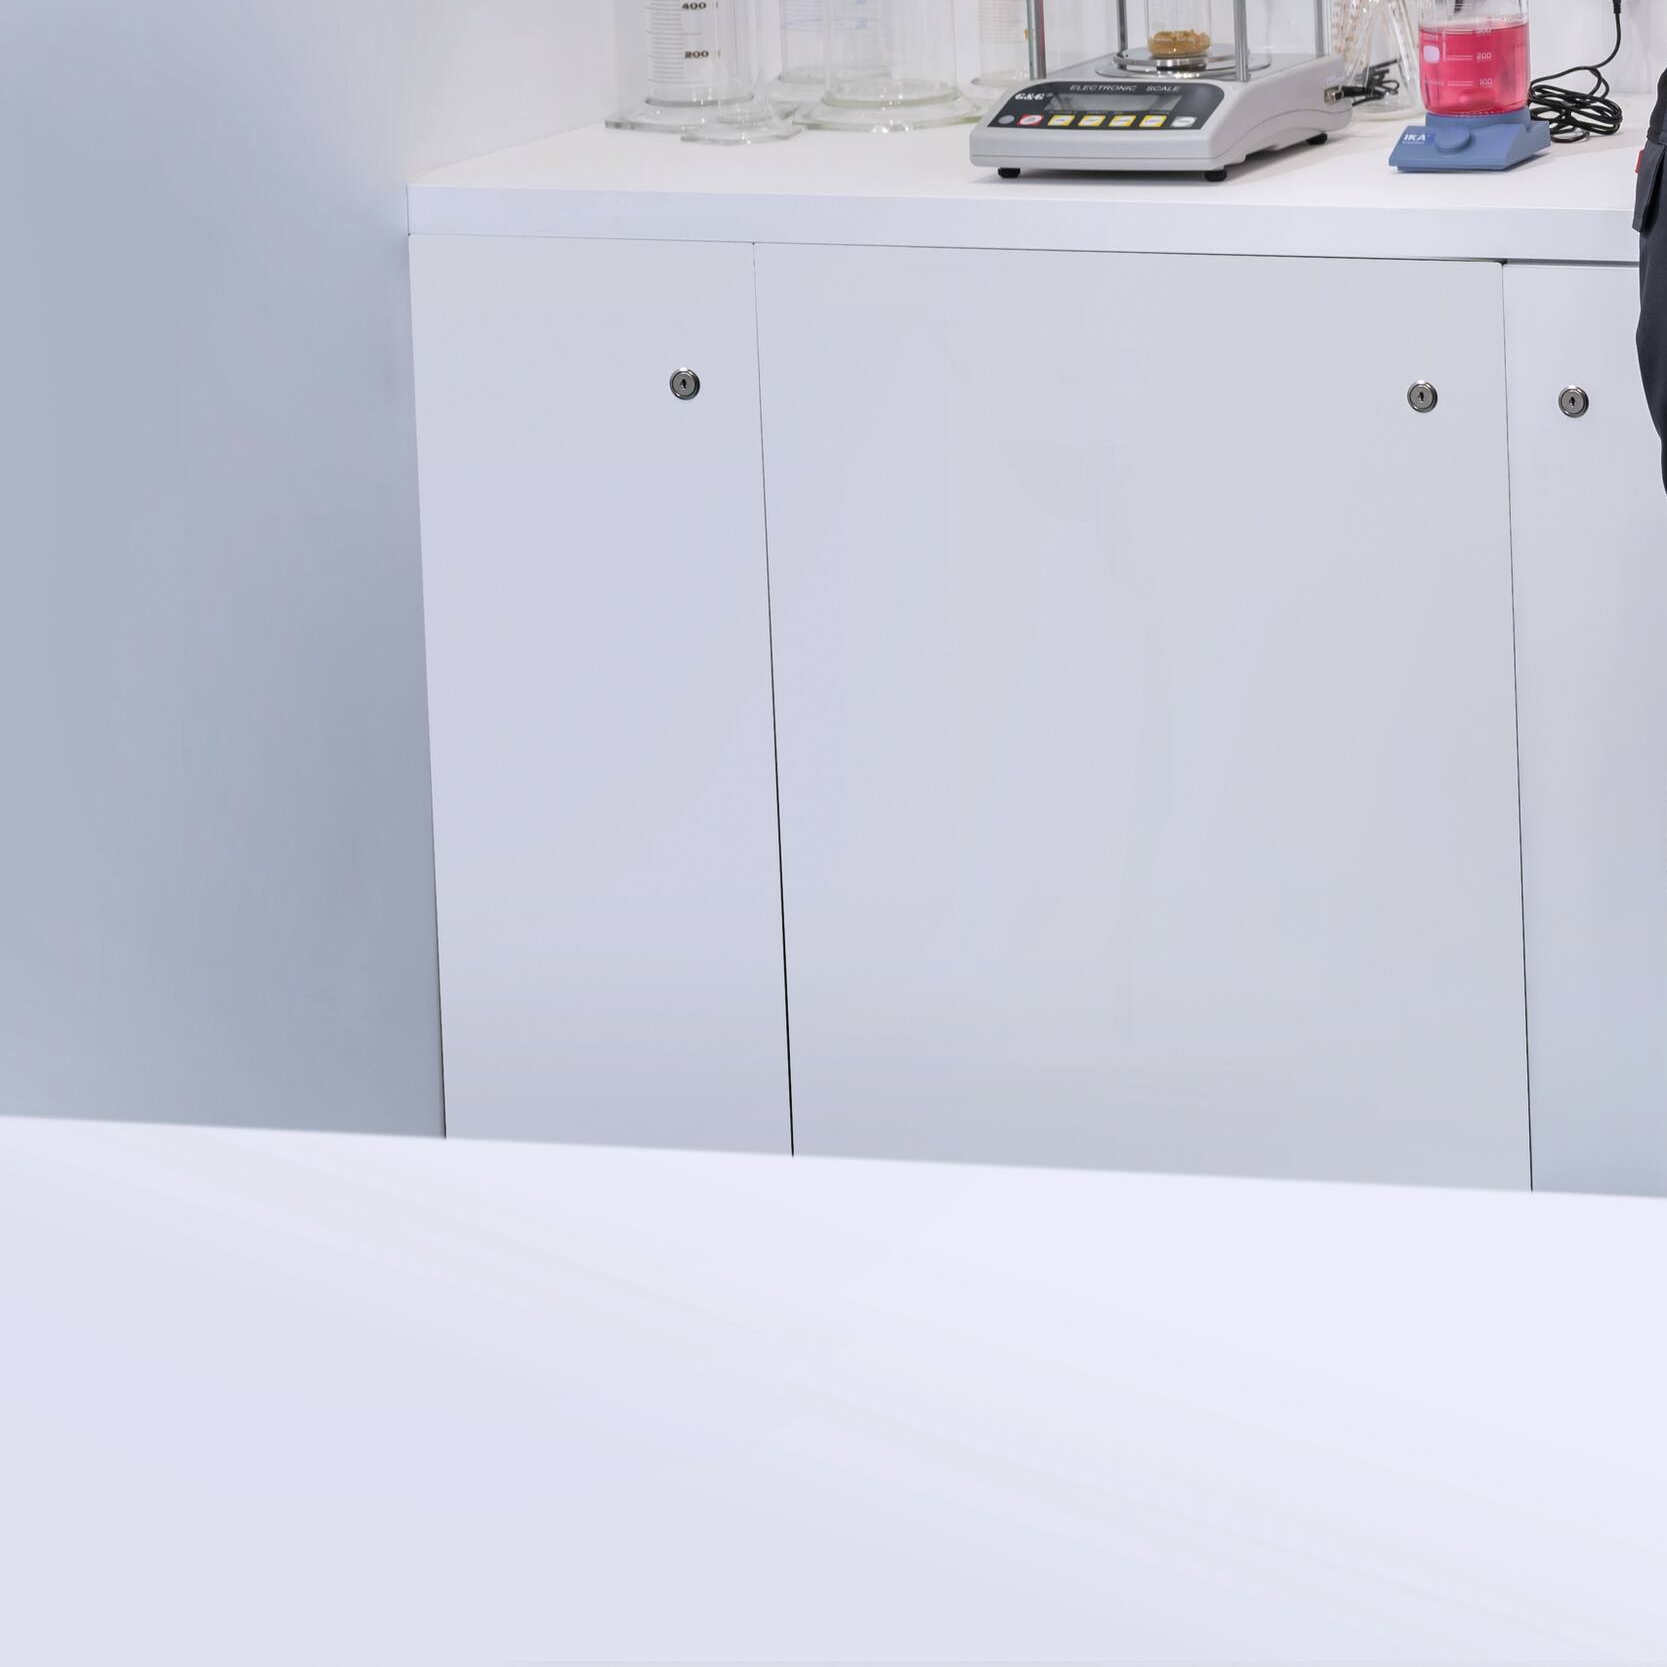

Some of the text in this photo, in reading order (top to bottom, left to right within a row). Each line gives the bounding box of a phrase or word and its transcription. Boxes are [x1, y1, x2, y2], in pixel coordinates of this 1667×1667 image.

[681, 2, 707, 10] 400
[684, 50, 709, 59] 200
[1476, 52, 1492, 61] 200
[1479, 77, 1494, 86] 100
[1069, 84, 1181, 92] ELECTRONIC SCALE
[1403, 133, 1426, 142] IKA
